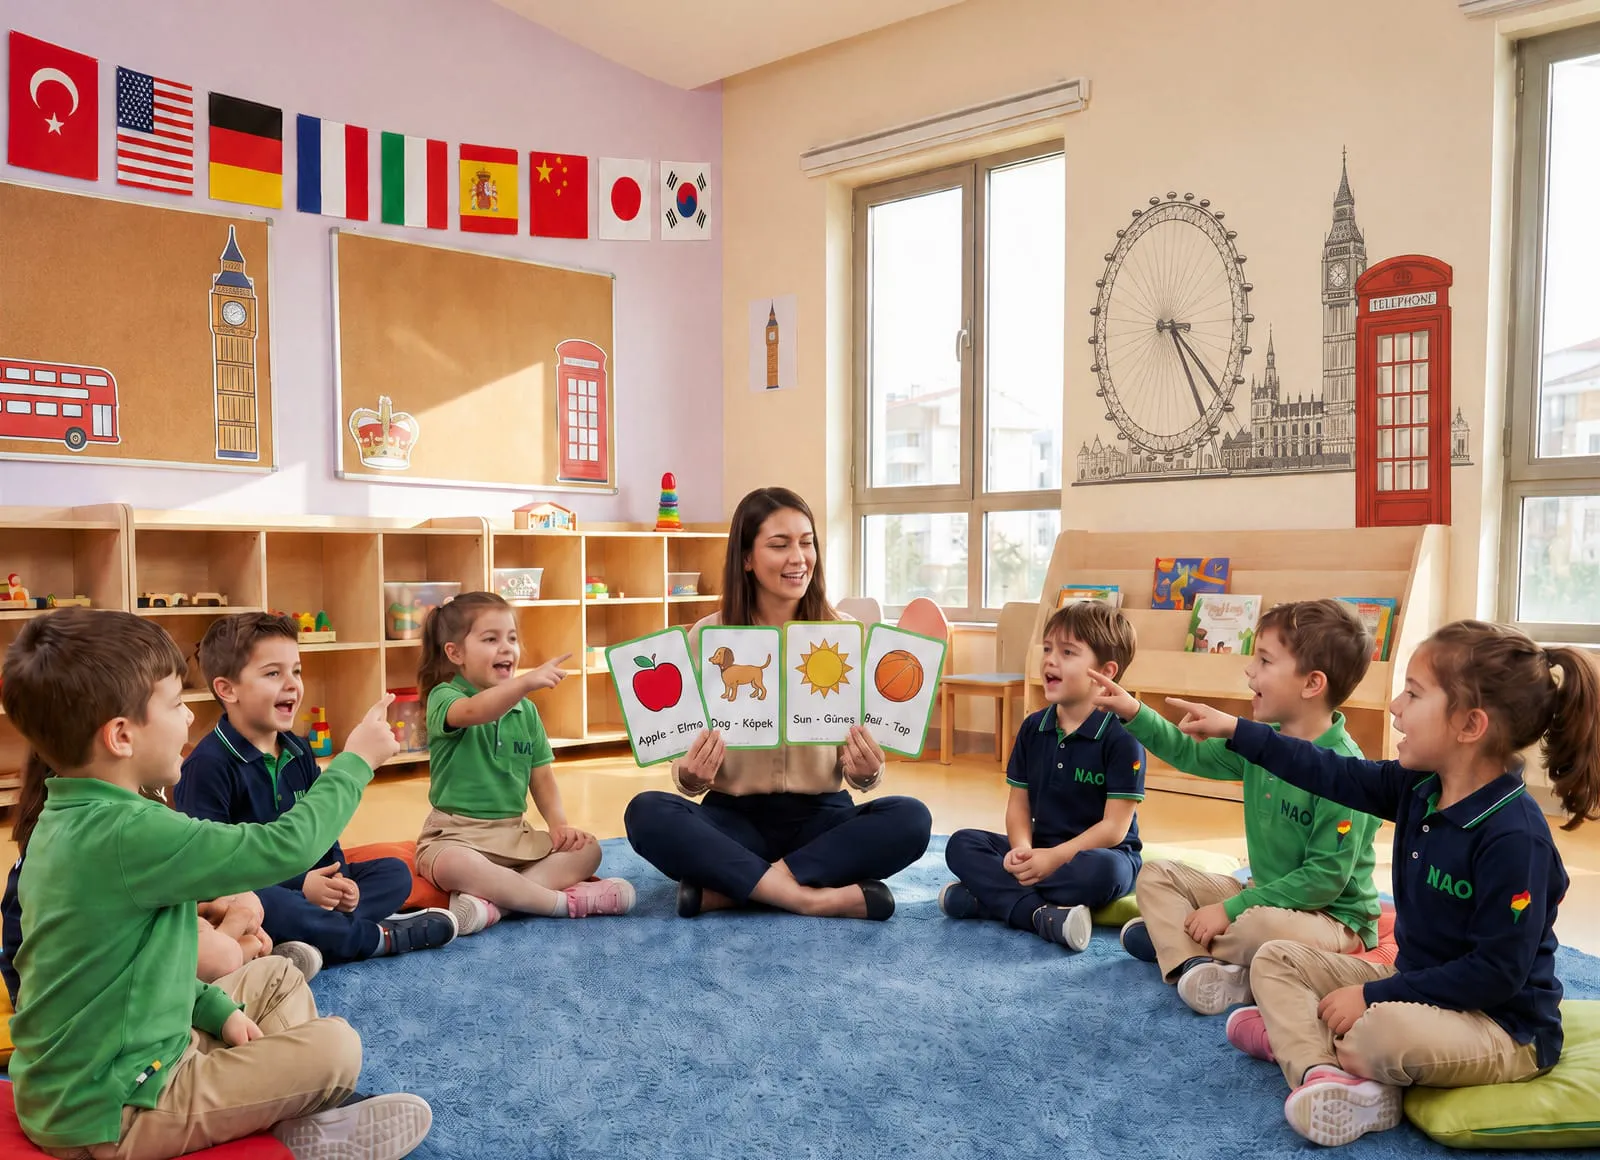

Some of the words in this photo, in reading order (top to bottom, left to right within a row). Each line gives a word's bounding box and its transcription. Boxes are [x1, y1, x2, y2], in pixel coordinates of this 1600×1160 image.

[711, 718, 731, 731] Dog
[793, 714, 812, 724] Sun
[893, 721, 911, 737] Top
[638, 730, 667, 747] Apple
[1074, 767, 1105, 785] NAO
[1281, 799, 1313, 826] NAO
[1426, 864, 1473, 899] NAO
